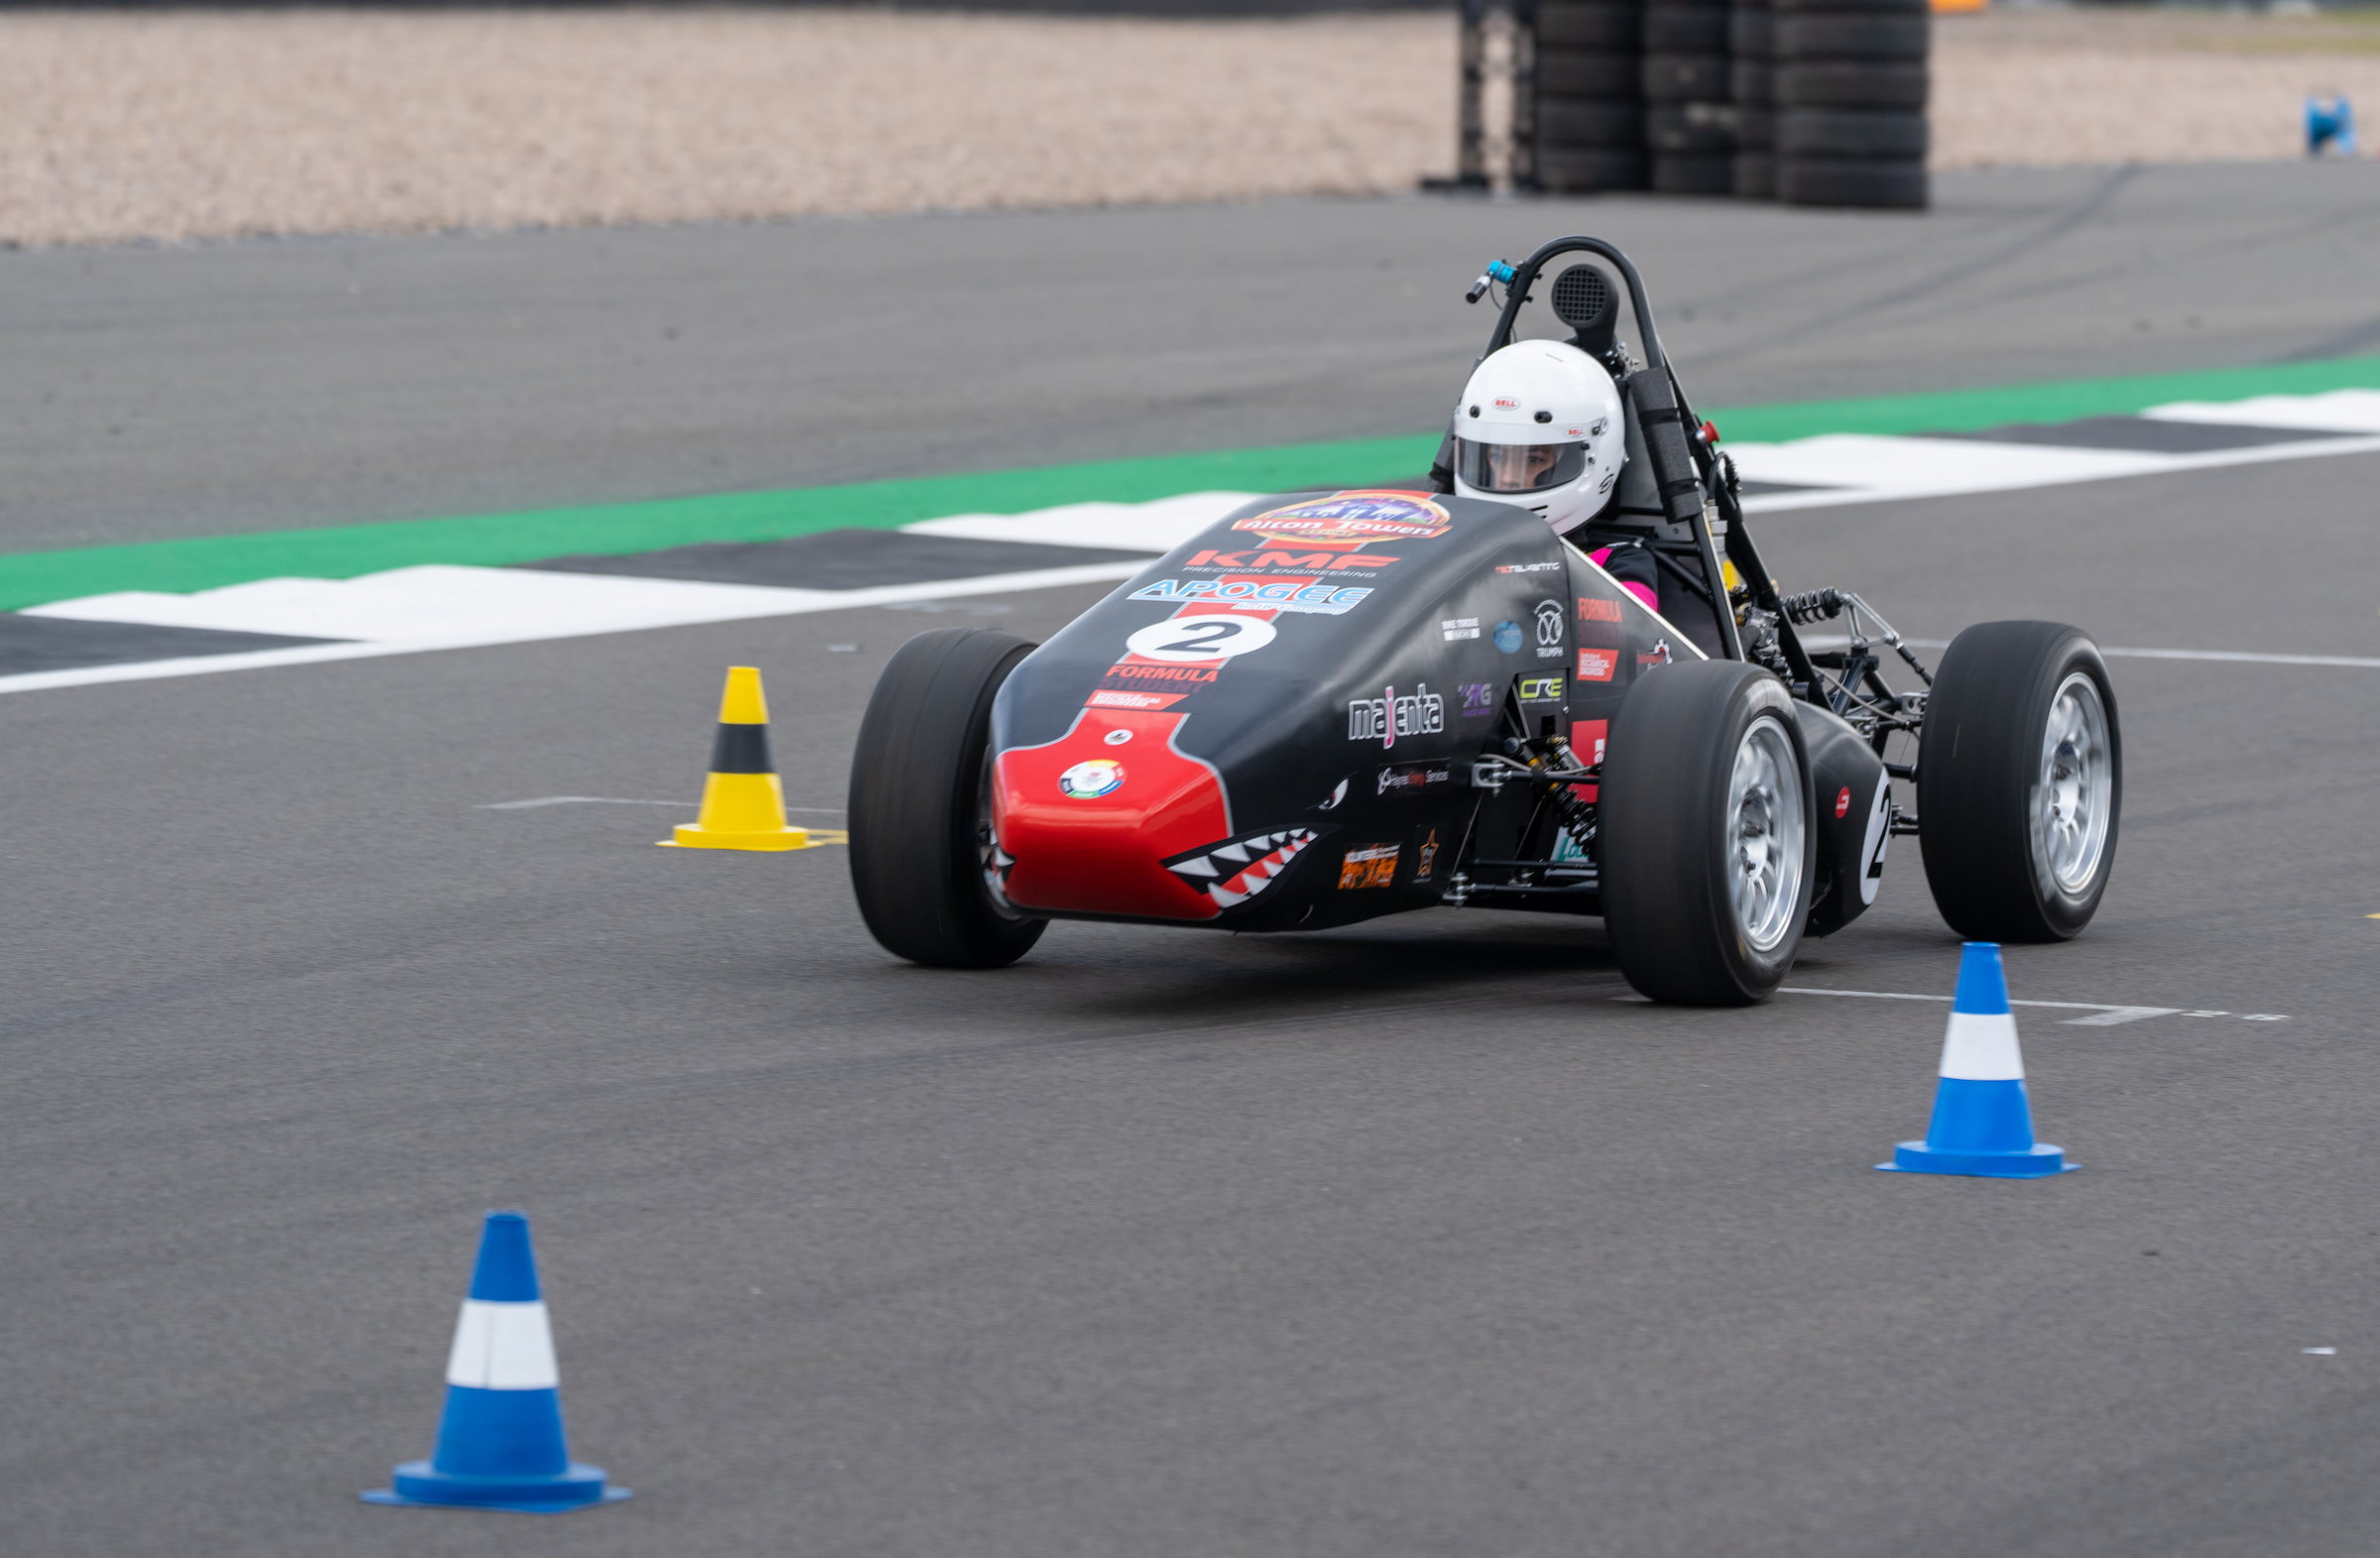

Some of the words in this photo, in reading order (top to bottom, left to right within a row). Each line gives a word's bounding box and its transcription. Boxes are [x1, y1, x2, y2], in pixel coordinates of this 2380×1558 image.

[1243, 519, 1323, 532] Alton
[1334, 520, 1436, 537] Towers
[1181, 566, 1265, 575] PRECISION
[1270, 568, 1377, 578] ENGINEERING
[1185, 549, 1402, 571] KMF
[1130, 578, 1374, 606] APOGEE
[1578, 597, 1623, 623] FORMULA
[1153, 621, 1243, 654] 2
[1097, 676, 1210, 694] STUDENT
[1105, 664, 1219, 683] FORMULA
[1349, 682, 1445, 751] majenta
[1866, 783, 1892, 879] 2
